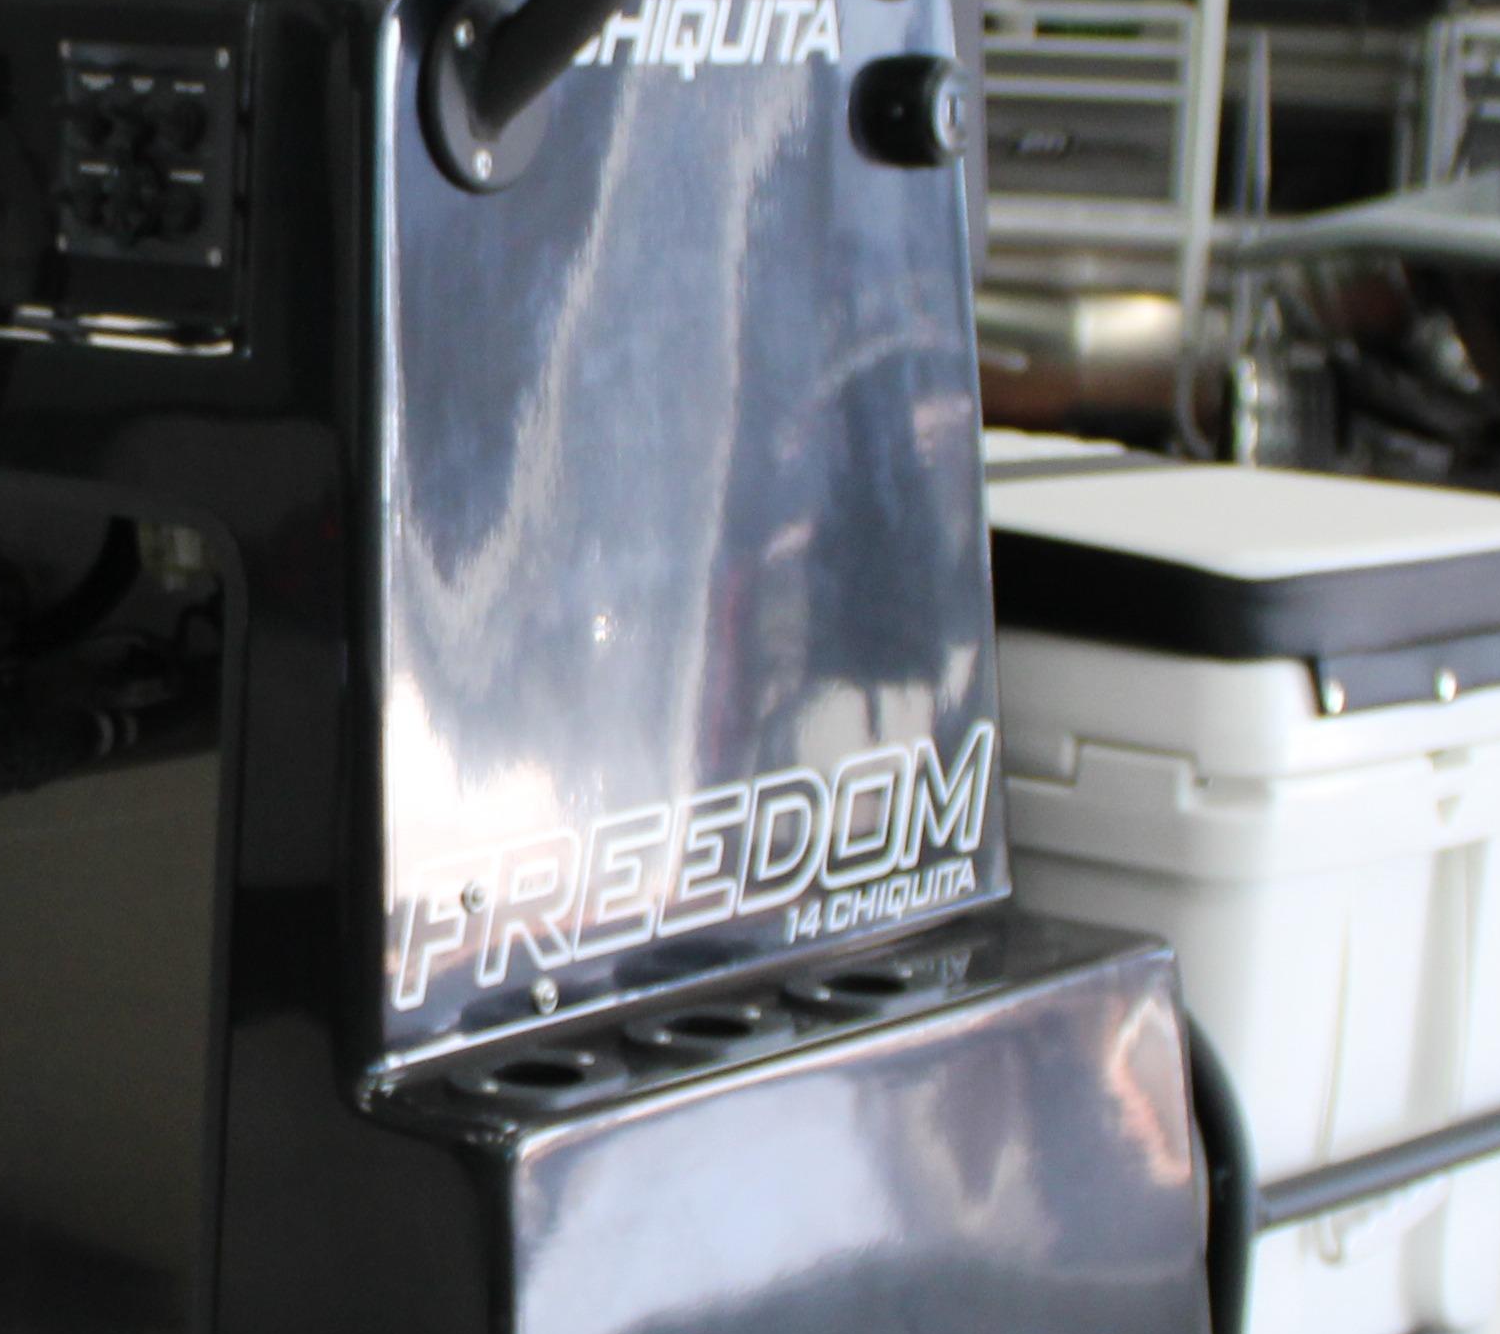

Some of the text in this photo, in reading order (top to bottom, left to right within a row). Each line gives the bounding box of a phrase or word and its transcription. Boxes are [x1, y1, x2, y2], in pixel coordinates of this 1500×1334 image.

[390, 720, 995, 1012] FREEDOM
[786, 855, 977, 945] 14 CHIQUITA
